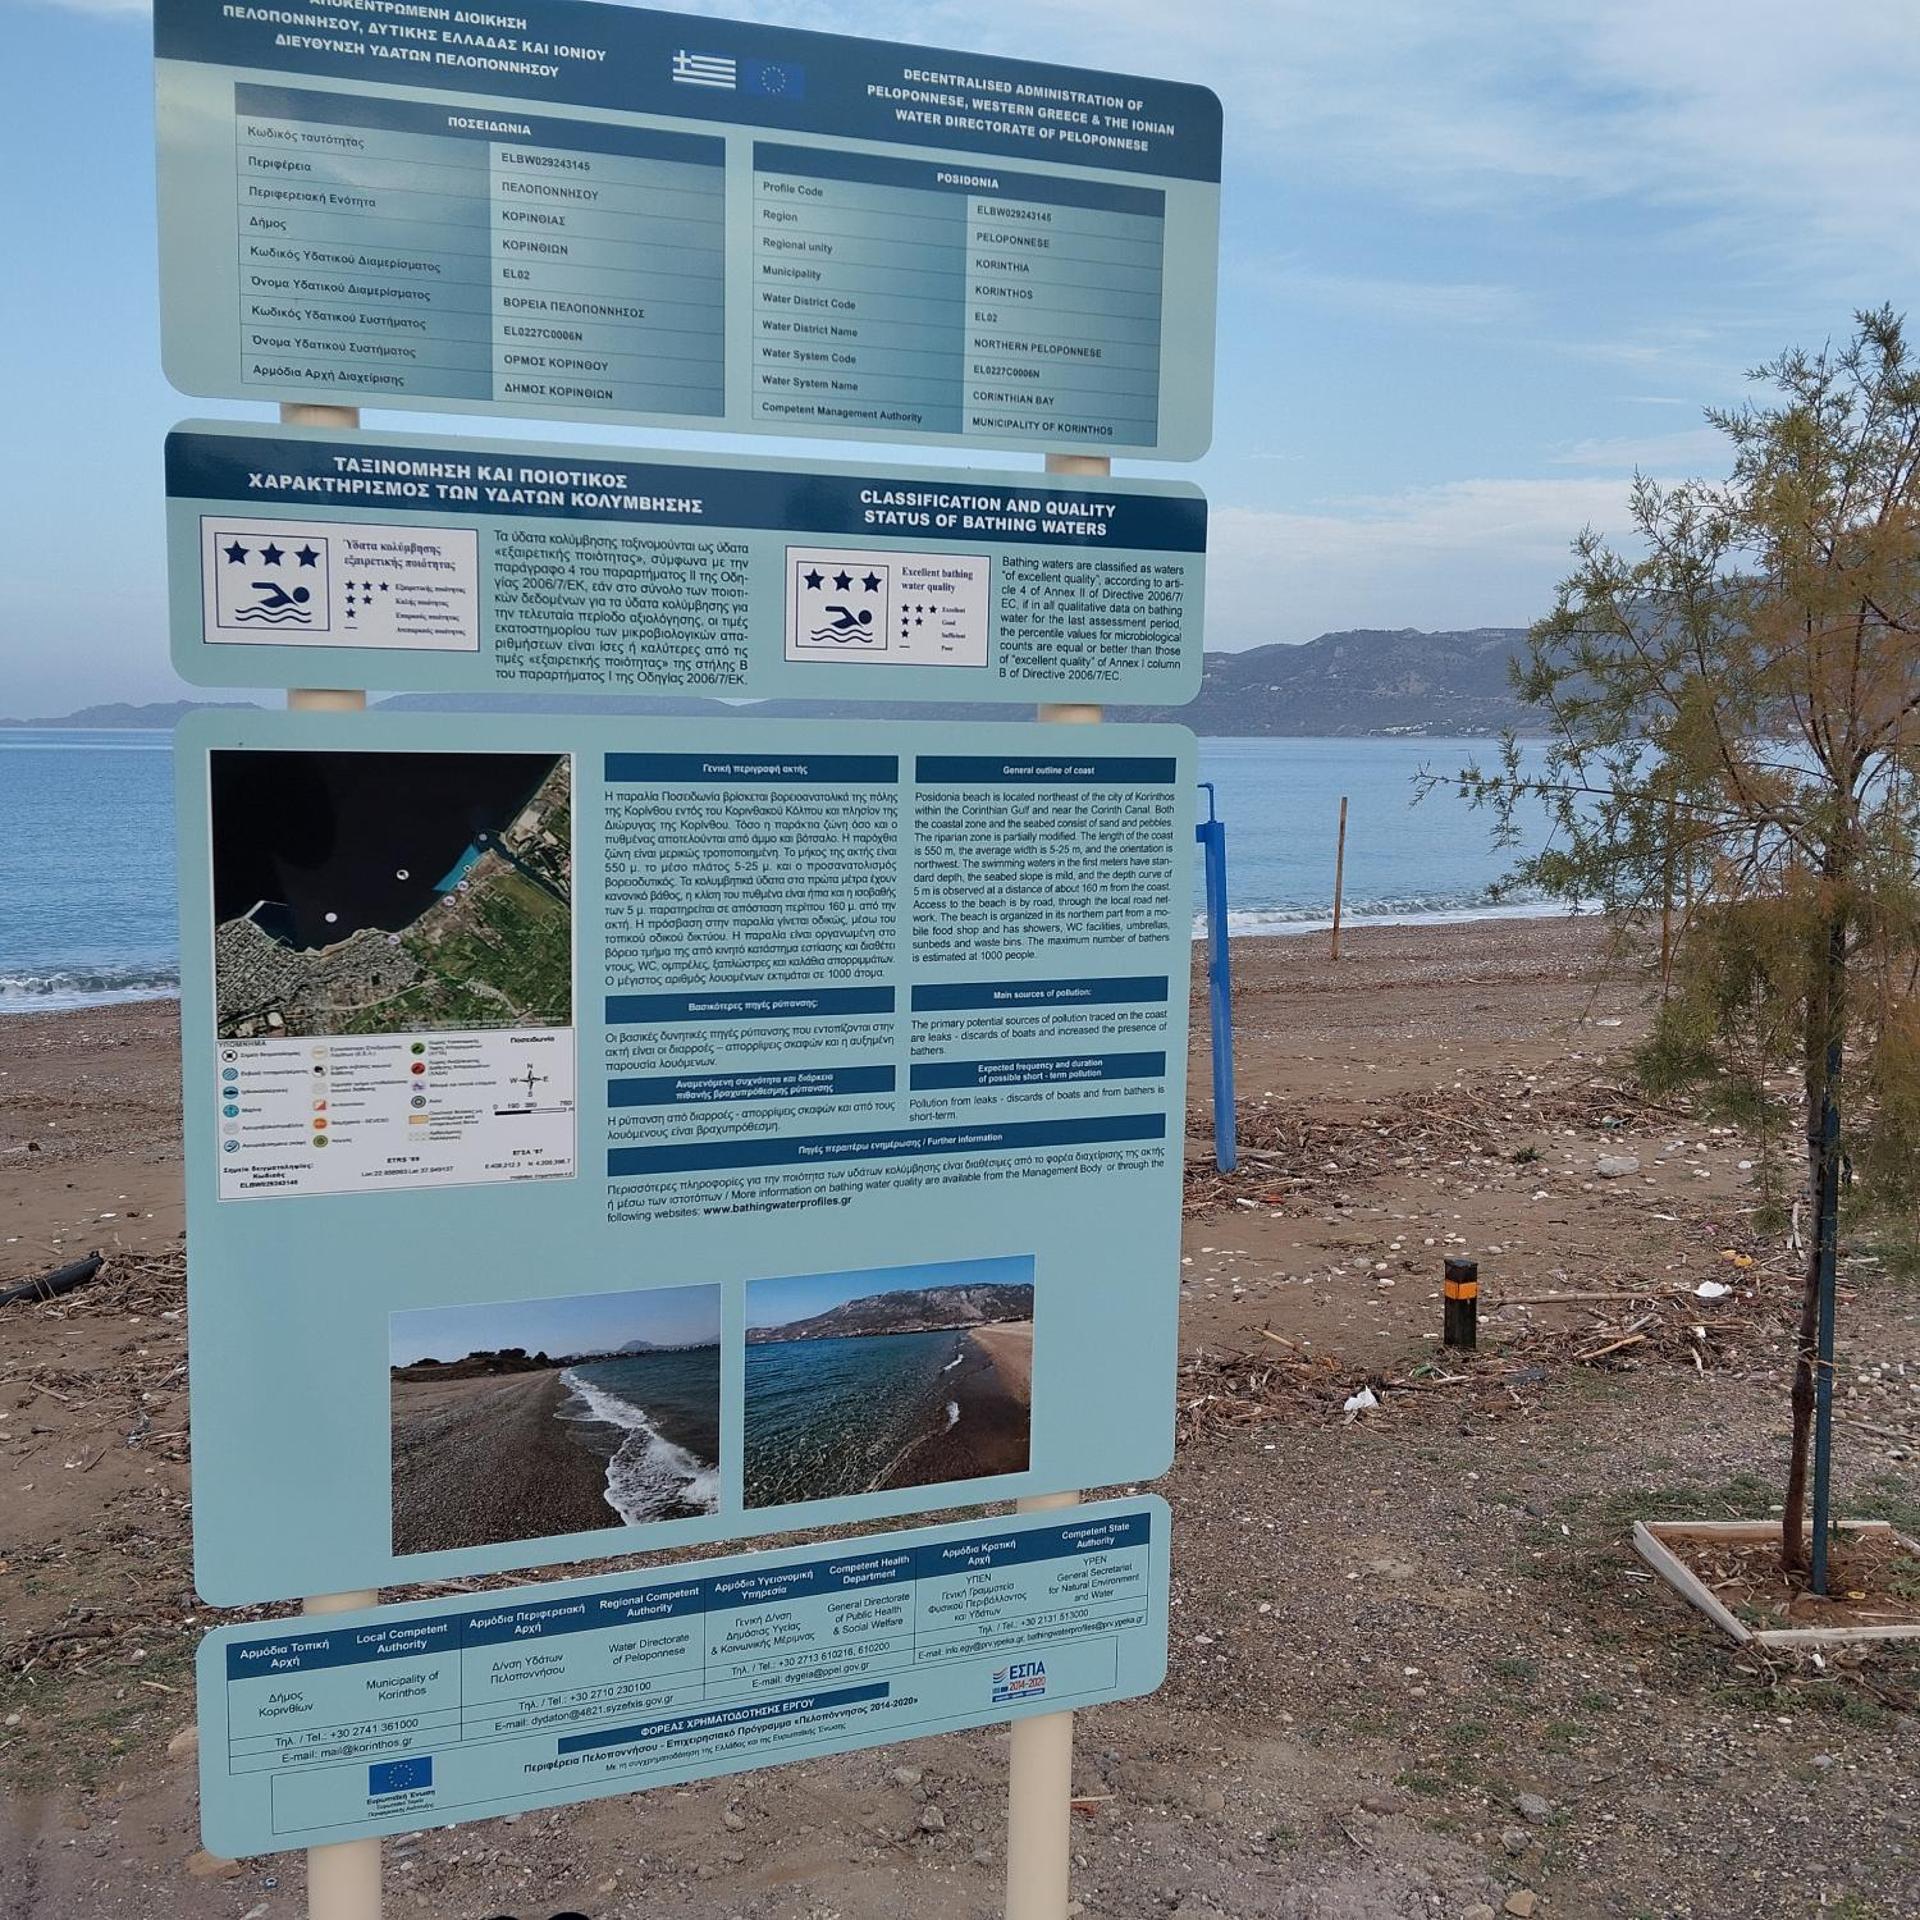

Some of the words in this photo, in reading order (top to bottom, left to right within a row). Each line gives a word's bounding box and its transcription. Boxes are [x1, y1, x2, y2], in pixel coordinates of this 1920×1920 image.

[454, 11, 526, 28] ΔΙΟΙΚΗΣΗ
[223, 6, 362, 32] ΠΕΛΟΠΟΝΝΗΣΟΥ,
[368, 23, 437, 40] ΔΥΤΙΚΗΣ
[442, 32, 517, 49] ΕΛΛΑΔΑΣ
[522, 41, 548, 53] ΚΑΙ
[553, 45, 605, 60] ΙΟΝΙΟΥ
[275, 35, 364, 53] ΔΙΕΥΘΥΝΣΗ
[369, 45, 430, 61] ΥΔΑΤΩΝ
[435, 53, 558, 75] ΠΕΛΟΠΟΝΝΗΣΟΥ
[904, 69, 1011, 91] DECENTRALISED
[1016, 85, 1123, 107] ADMINISTRATION
[1127, 100, 1142, 109] OF
[867, 85, 968, 107] PELOPONNESE,
[972, 99, 1033, 115] WESTERN
[1037, 108, 1087, 122] GREECE
[1091, 115, 1099, 124] &
[1104, 116, 1127, 128] THE
[1132, 120, 1174, 134] IONIAN
[448, 117, 530, 133] ΠΟΣΕΙΔΩΝΙΑ
[895, 109, 940, 123] WATER
[945, 116, 1034, 135] DIRECTORATE
[1038, 127, 1055, 138] OF
[1059, 130, 1147, 150] PELOPONNESE
[247, 127, 297, 141] Κωδικός
[300, 134, 364, 148] ταυτότητας
[248, 156, 311, 170] Περιφέρεια
[763, 181, 795, 192] Profile
[797, 185, 823, 196] Code
[937, 173, 998, 187] POSIDONIA
[502, 182, 598, 199] ΠΕΛΟΠΟΝΝΗΣΟΥ
[249, 217, 286, 230] Δήμος
[502, 211, 565, 225] ΚΟΡΙΝΘΙΑΣ
[763, 209, 797, 221] Region
[502, 240, 567, 253] ΚΟΡΙΝΘΙΩΝ
[762, 237, 805, 249] Regional
[808, 243, 832, 254] unity
[977, 233, 1049, 247] PELOPONNESE
[502, 268, 529, 279] EL02
[762, 266, 821, 280] Municipality
[976, 260, 1029, 271] KORINTHIA
[975, 286, 1032, 298] KORINTHOS
[503, 297, 547, 308] ΒΟΡΕΙΑ
[550, 302, 645, 317] ΠΕΛΟΠΟΝΝΗΣΟΣ
[762, 293, 790, 302] Water
[793, 296, 828, 306] District
[830, 299, 855, 309] Code
[974, 312, 997, 322] EL02
[974, 339, 1028, 350] NORTHERN
[1031, 344, 1101, 357] PELOPONNESE
[503, 355, 545, 365] ΟΡΜΟΣ
[548, 358, 608, 370] ΚΟΡΙΝΘΟΥ
[252, 365, 301, 376] Αρμόδια
[304, 369, 334, 380] Αρχή
[337, 371, 404, 386] Διαχείρισης
[504, 383, 545, 393] ΔΗΜΟΣ
[549, 387, 612, 398] ΚΟΡΙΝΘΙΩΝ
[973, 392, 1032, 402] CORINTHIAN
[1035, 396, 1054, 404] BAY
[762, 403, 814, 413] Competent
[817, 406, 877, 418] Management
[879, 411, 922, 423] Authority
[972, 418, 1039, 428] MUNICIPALITY
[1042, 422, 1054, 430] OF
[1057, 423, 1112, 435] KORINTHOS
[333, 457, 470, 477] ΤΑΞΙΝΟΜΗΣΗ
[477, 466, 512, 480] ΚΑΙ
[519, 469, 626, 487] ΠΟΙΟΤΙΚΟΣ
[249, 474, 429, 496] ΧΑΡΑΚΤΗΡΙΣΜΟΣ
[435, 485, 477, 499] ΤΩΝ
[484, 488, 564, 504] ΥΔΑΤΩΝ
[571, 493, 702, 512] ΚΟΛΥΜΒΗΣΗΣ
[860, 491, 1000, 509] CLASSIFICATION
[1006, 499, 1040, 512] AND
[1046, 502, 1115, 516] QUALITY
[864, 510, 929, 525] STATUS
[935, 514, 957, 526] OF
[963, 516, 1036, 530] BATHING
[1042, 520, 1106, 534] WATERS
[902, 567, 939, 576] Excellent
[941, 569, 973, 579] bathing
[1002, 556, 1039, 569] Bathing
[1041, 560, 1073, 568] waters
[1094, 561, 1137, 571] classified
[1153, 565, 1184, 574] waters
[927, 583, 954, 593] quality
[999, 667, 1006, 677] B
[1009, 668, 1019, 677] of
[1022, 668, 1065, 678] Directive
[914, 792, 959, 801] Posidonia
[962, 792, 990, 801] beach
[1002, 792, 1035, 800] located
[1080, 792, 1089, 800] of
[1091, 792, 1105, 800] the
[1107, 793, 1122, 802] city
[1124, 792, 1133, 800] of
[1134, 792, 1174, 800] Korinthos
[607, 1208, 651, 1221] following
[703, 1197, 851, 1213] www.bathingwaterprofiles.gr
[1061, 1526, 1106, 1540] Competent
[1108, 1523, 1129, 1531] State
[1076, 1535, 1115, 1547] Authority
[829, 1560, 878, 1576] Competent
[881, 1556, 909, 1570] Health
[843, 1569, 895, 1583] Department
[599, 1595, 643, 1608] Regional
[645, 1587, 698, 1604] Competent
[626, 1602, 672, 1616] Authority
[356, 1632, 385, 1643] Local
[388, 1624, 447, 1638] Competent
[240, 1646, 287, 1658] Αρμόδια
[291, 1640, 328, 1654] Τοπική
[376, 1640, 426, 1652] Authority
[270, 1656, 299, 1667] Αρχή
[1010, 1660, 1045, 1680] ΕΣΠΑ
[366, 1675, 425, 1688] Municipality
[428, 1671, 439, 1680] of
[378, 1688, 426, 1699] Korinthos
[640, 1717, 684, 1735] ΦΟΡΕΑΣ
[686, 1705, 780, 1728] ΧΡΗΜΑΤΟΔΟΤΗΣΗΣ
[782, 1699, 814, 1716] ΕΡΓΟΥ
[330, 1728, 350, 1740] +30
[352, 1725, 376, 1739] 2741
[381, 1719, 419, 1732] 361000
